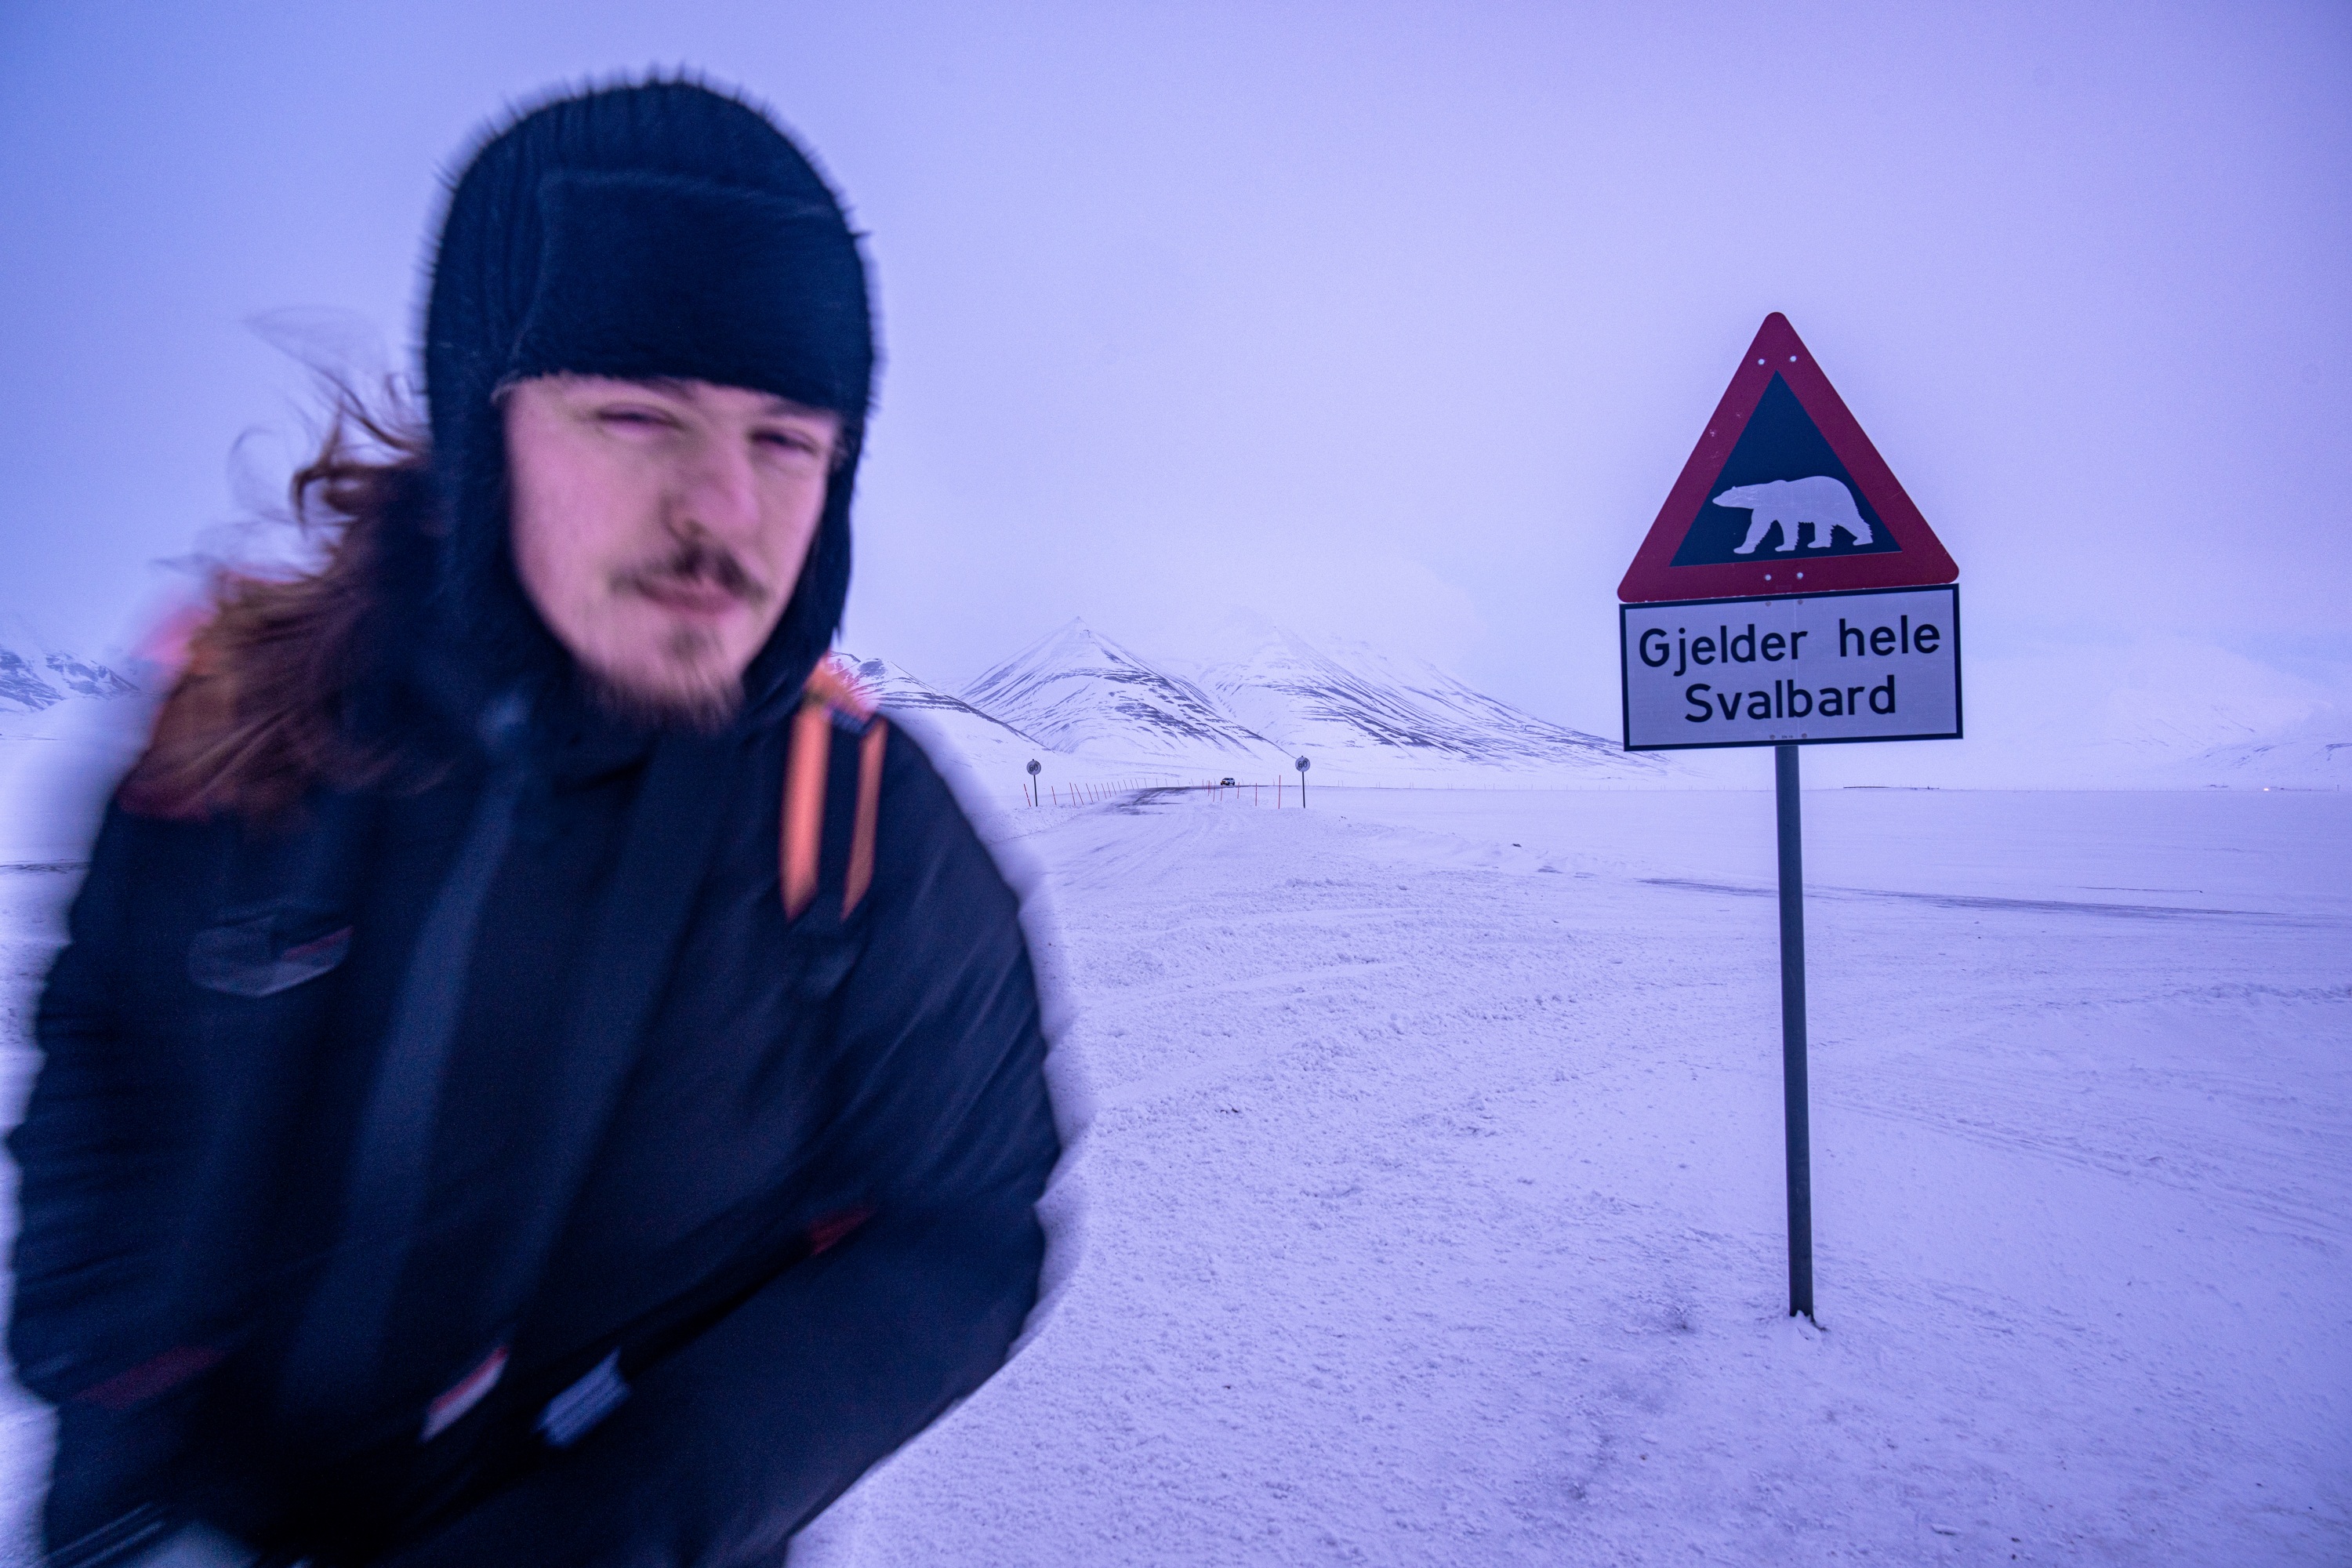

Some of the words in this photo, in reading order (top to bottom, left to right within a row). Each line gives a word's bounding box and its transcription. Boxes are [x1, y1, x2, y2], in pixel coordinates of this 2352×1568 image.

[1639, 623, 1809, 677] Gjelder
[1839, 615, 1940, 658] hele
[1685, 674, 1896, 723] Svalbard
